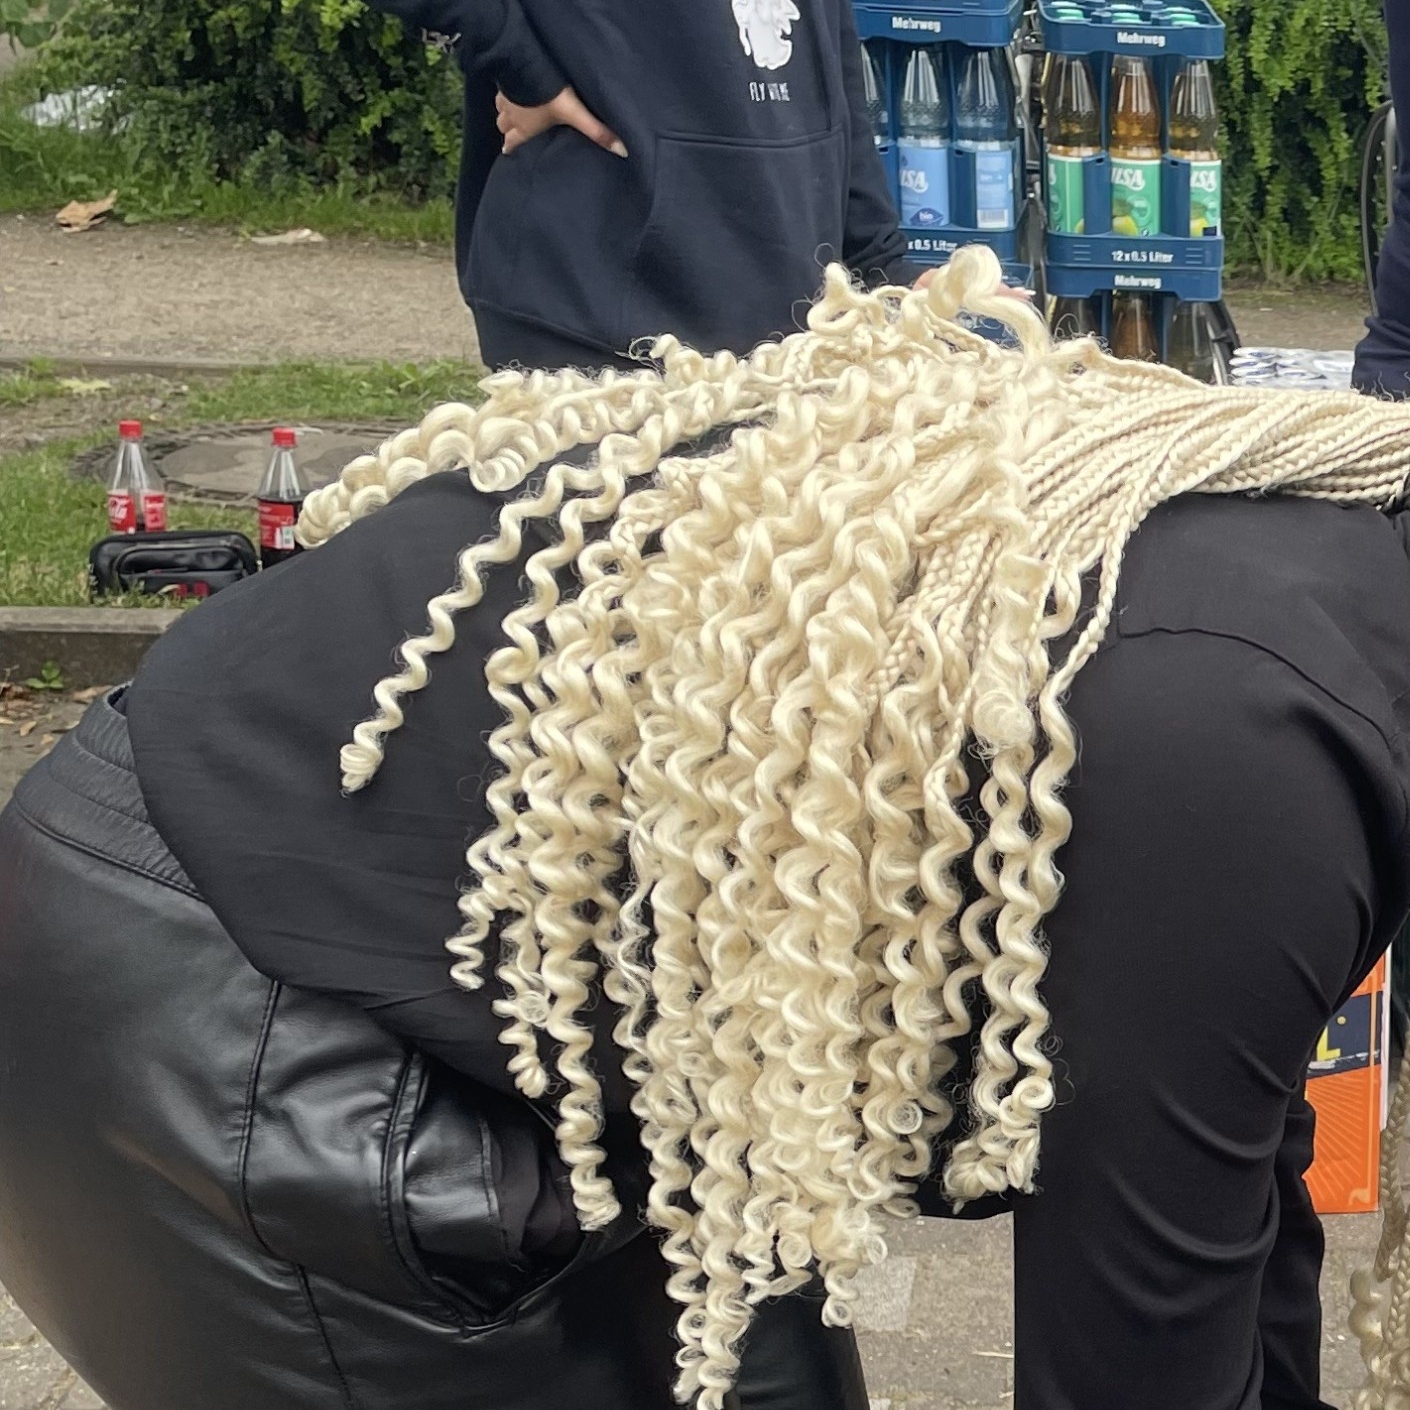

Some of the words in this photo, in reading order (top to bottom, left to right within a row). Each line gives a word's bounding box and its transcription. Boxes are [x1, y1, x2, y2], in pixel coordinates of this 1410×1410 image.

[892, 16, 941, 33] Mehrweg
[1117, 32, 1166, 47] Mehrweg
[1111, 250, 1123, 262] 12
[1115, 274, 1161, 290] Mehrweg
